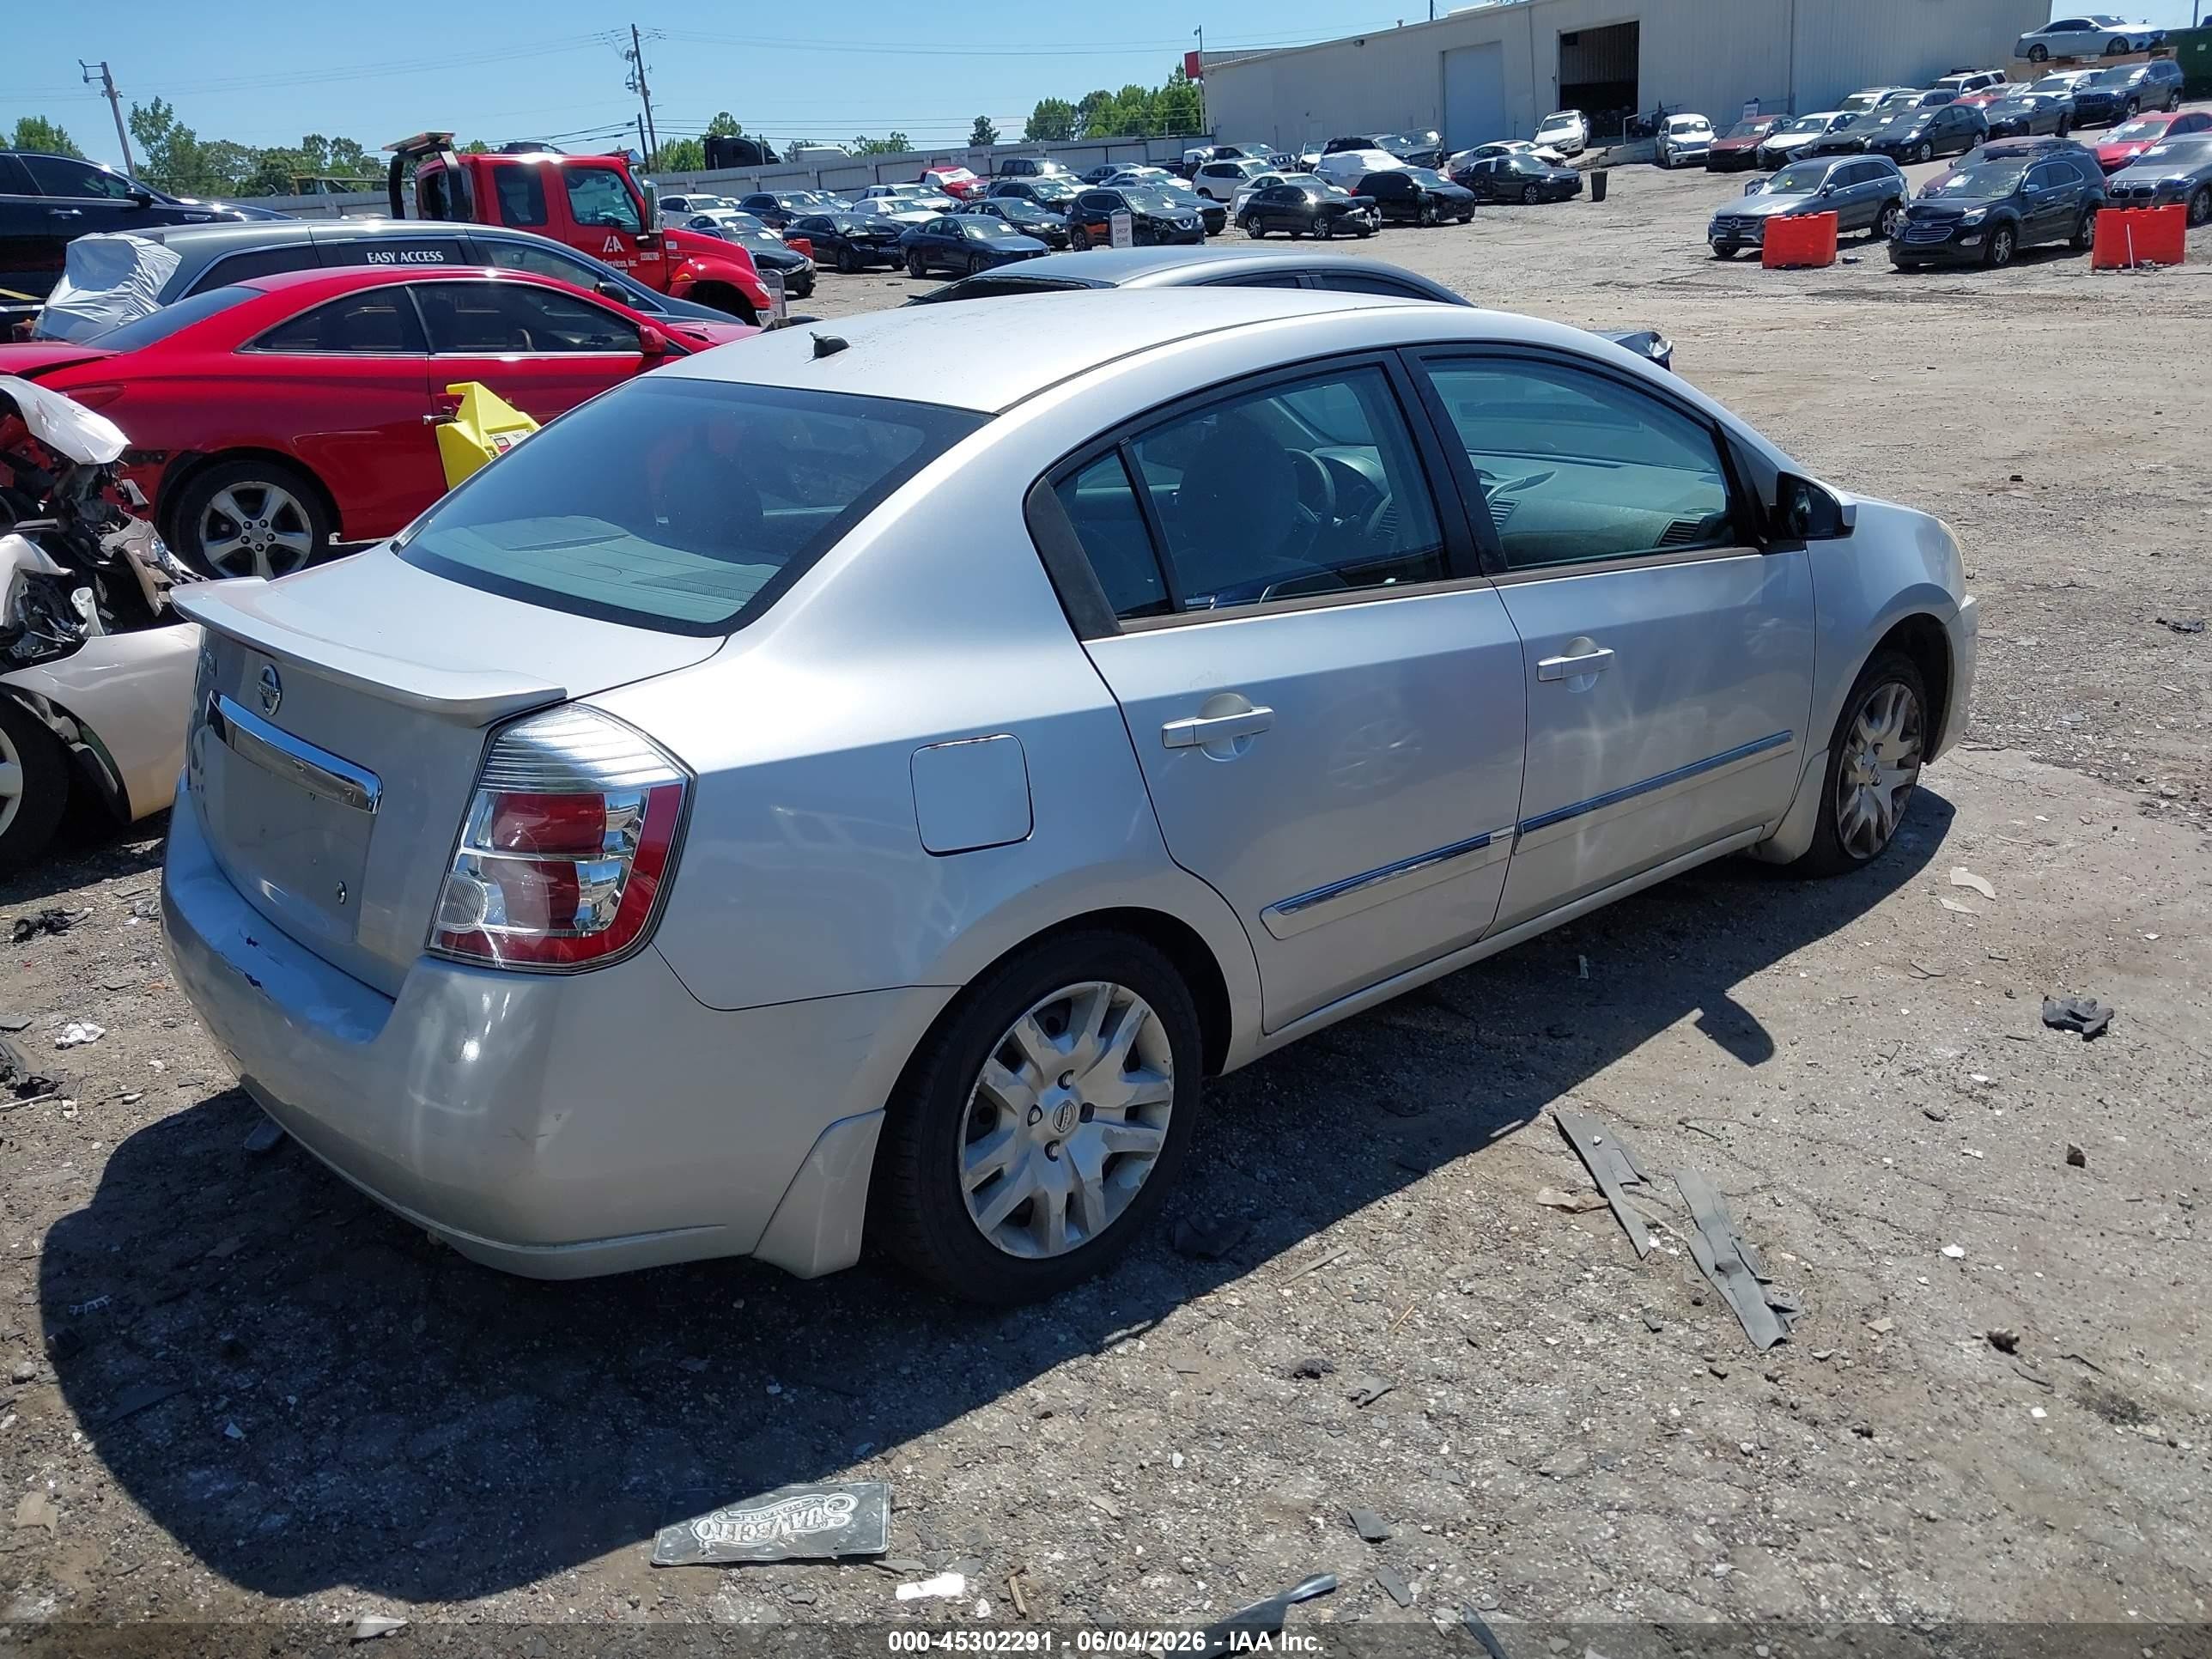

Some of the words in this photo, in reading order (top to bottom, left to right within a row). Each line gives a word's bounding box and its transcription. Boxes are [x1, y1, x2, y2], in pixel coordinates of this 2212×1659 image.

[367, 252, 396, 264] EASY
[400, 251, 445, 263] ACCESS
[691, 1493, 859, 1547] SUAVECITO
